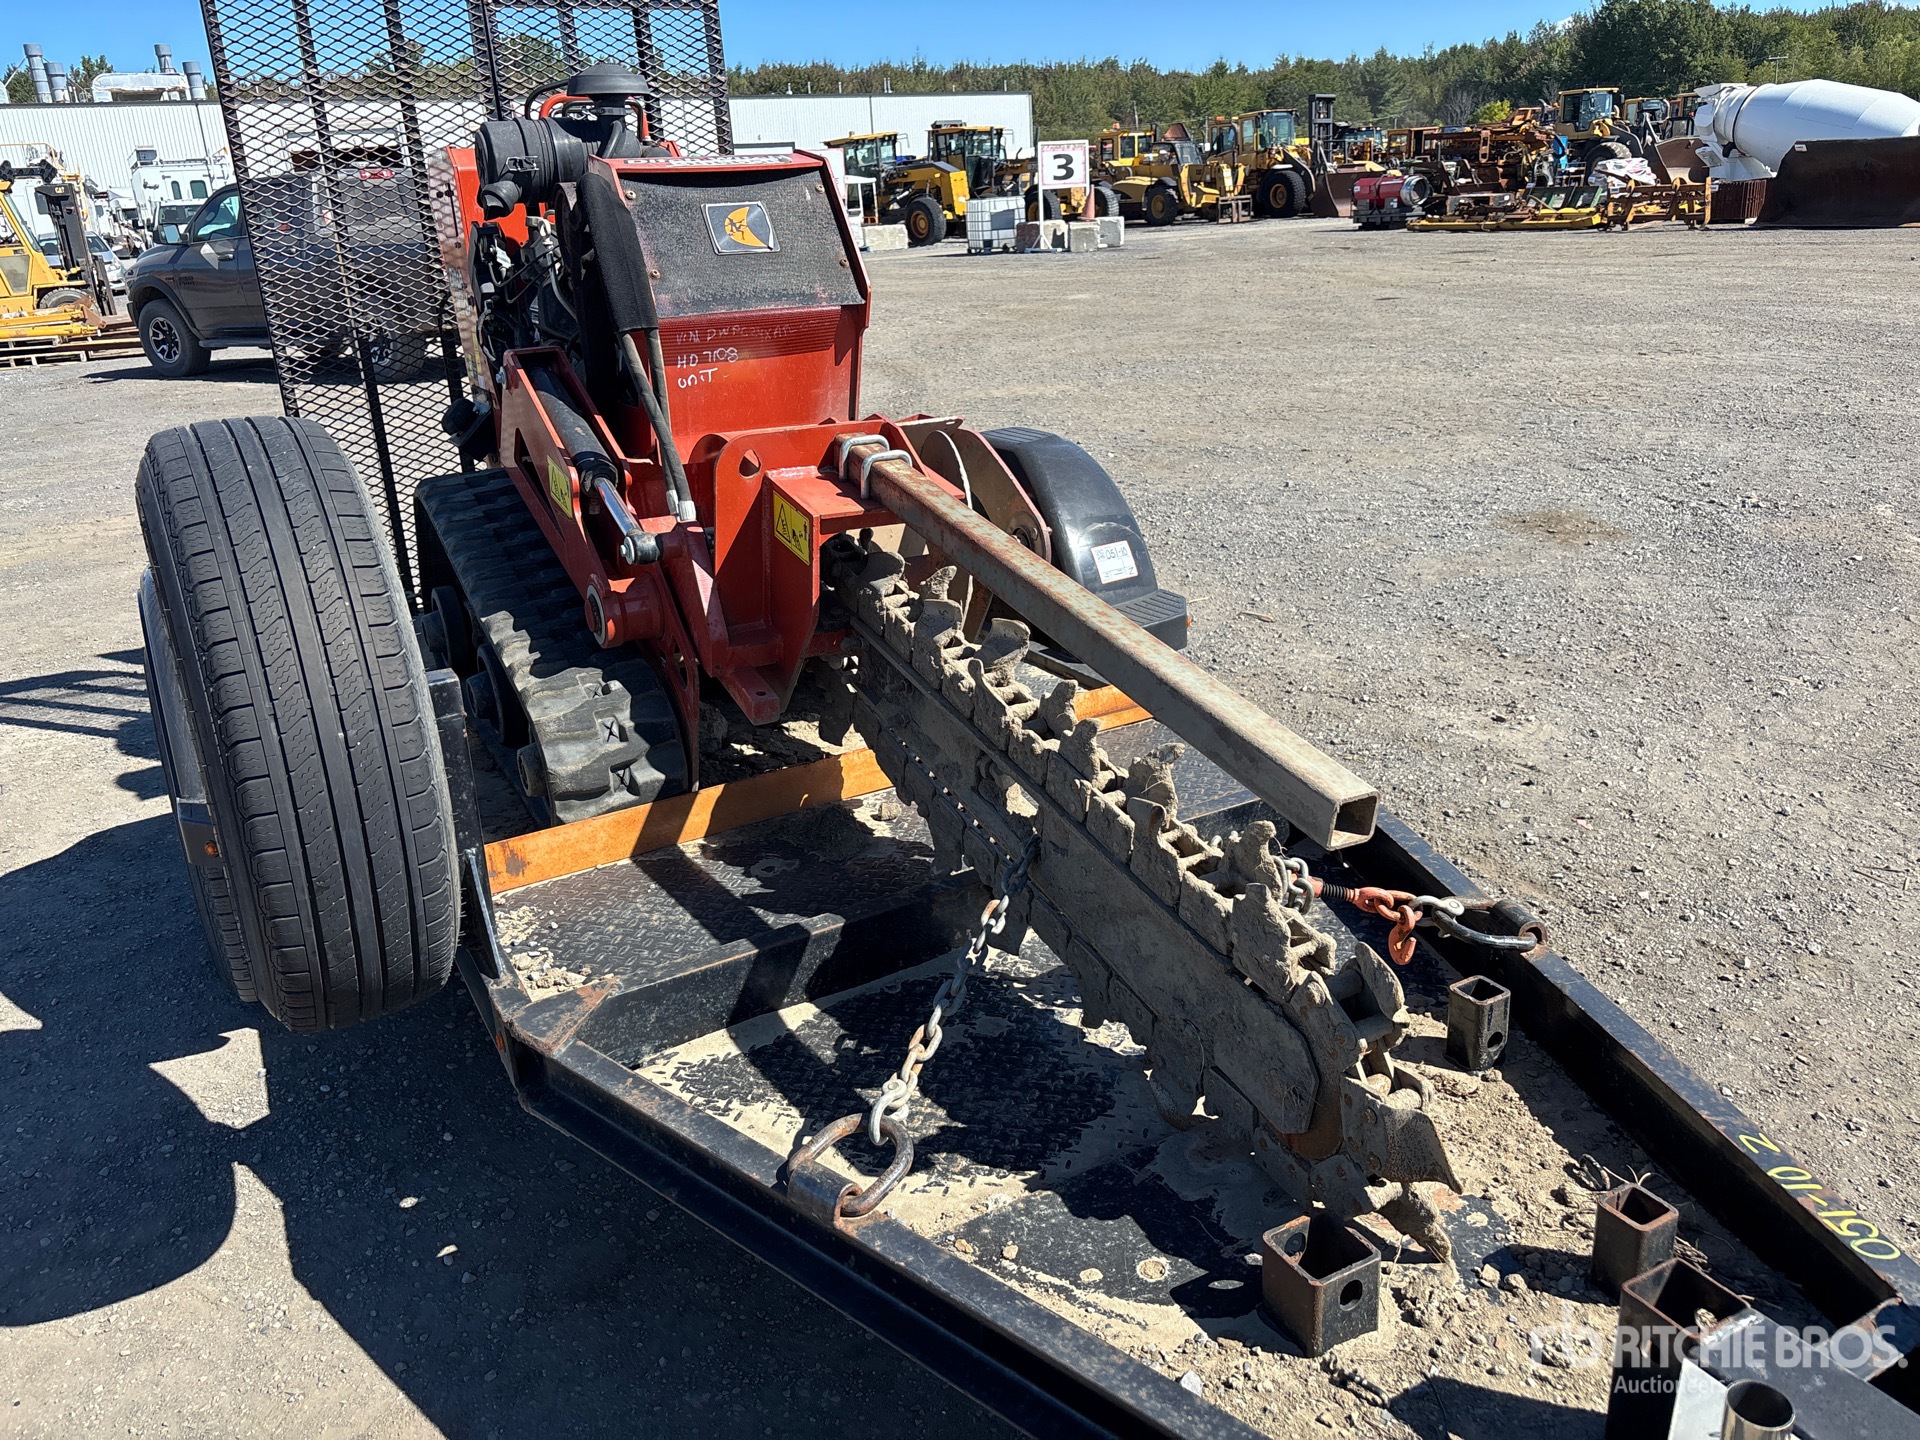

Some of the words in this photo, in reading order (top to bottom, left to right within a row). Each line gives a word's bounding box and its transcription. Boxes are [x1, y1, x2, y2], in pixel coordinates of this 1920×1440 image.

[1053, 153, 1075, 181] 3
[677, 353, 699, 368] HD
[702, 347, 739, 363] 7108
[1766, 1166, 1901, 1260] 051-10
